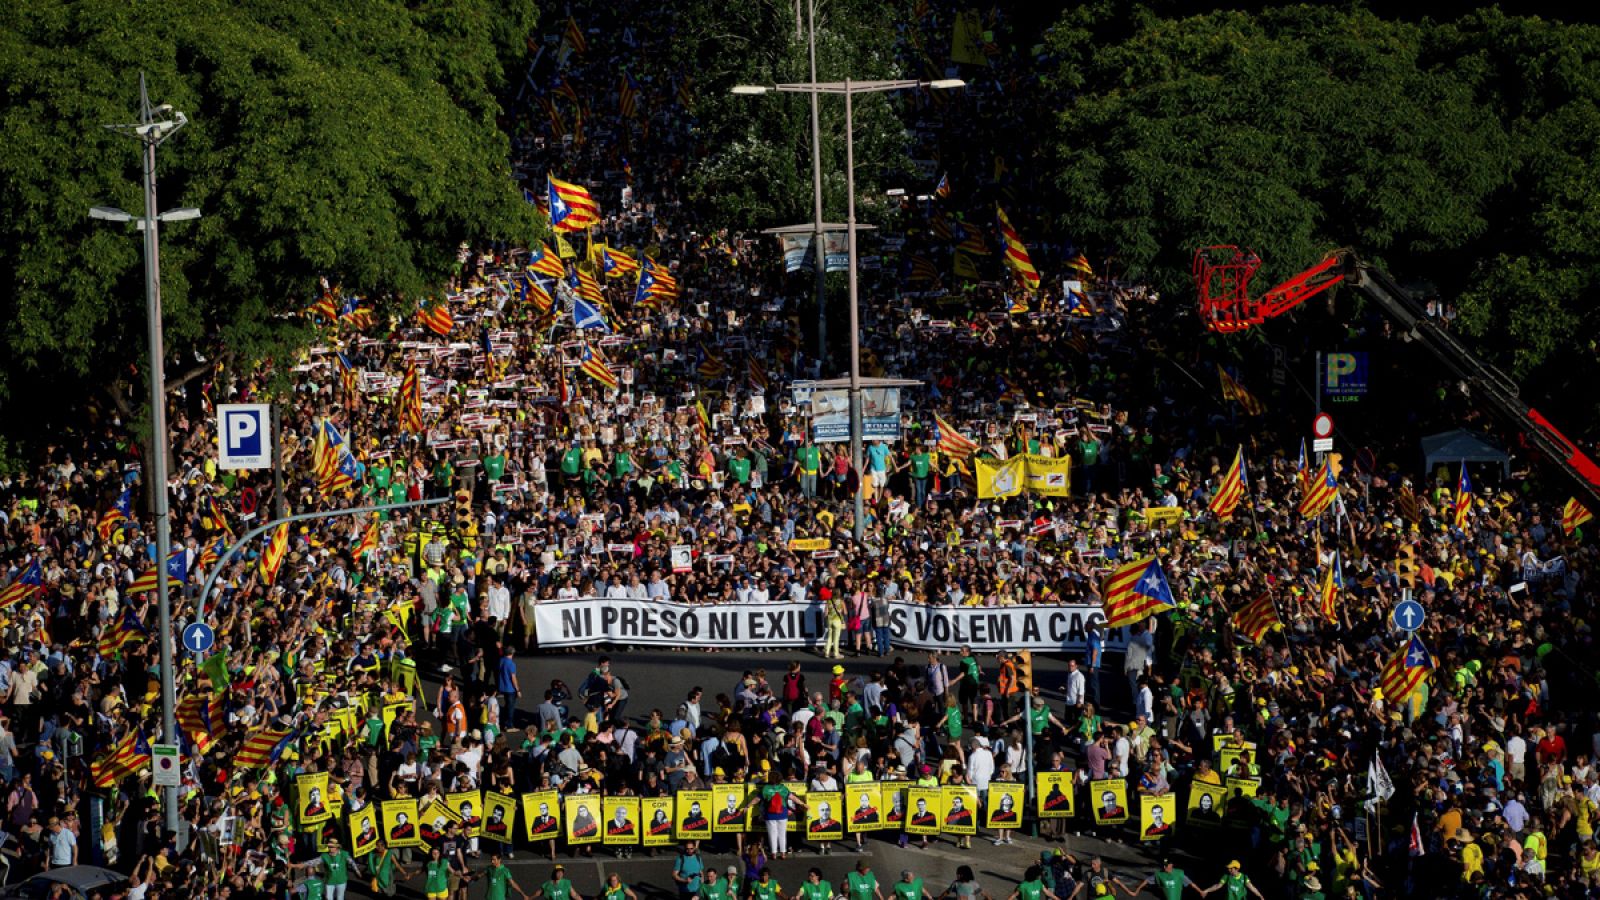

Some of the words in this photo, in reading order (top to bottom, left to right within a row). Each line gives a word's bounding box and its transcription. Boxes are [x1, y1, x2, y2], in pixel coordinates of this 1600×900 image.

[1327, 352, 1357, 388] P
[228, 412, 257, 449] P
[561, 606, 593, 638] NI
[601, 606, 699, 639] PRESÓ
[708, 611, 738, 640] NI
[889, 608, 908, 638] S
[914, 611, 1013, 643] VOLEM
[1021, 613, 1041, 642] A
